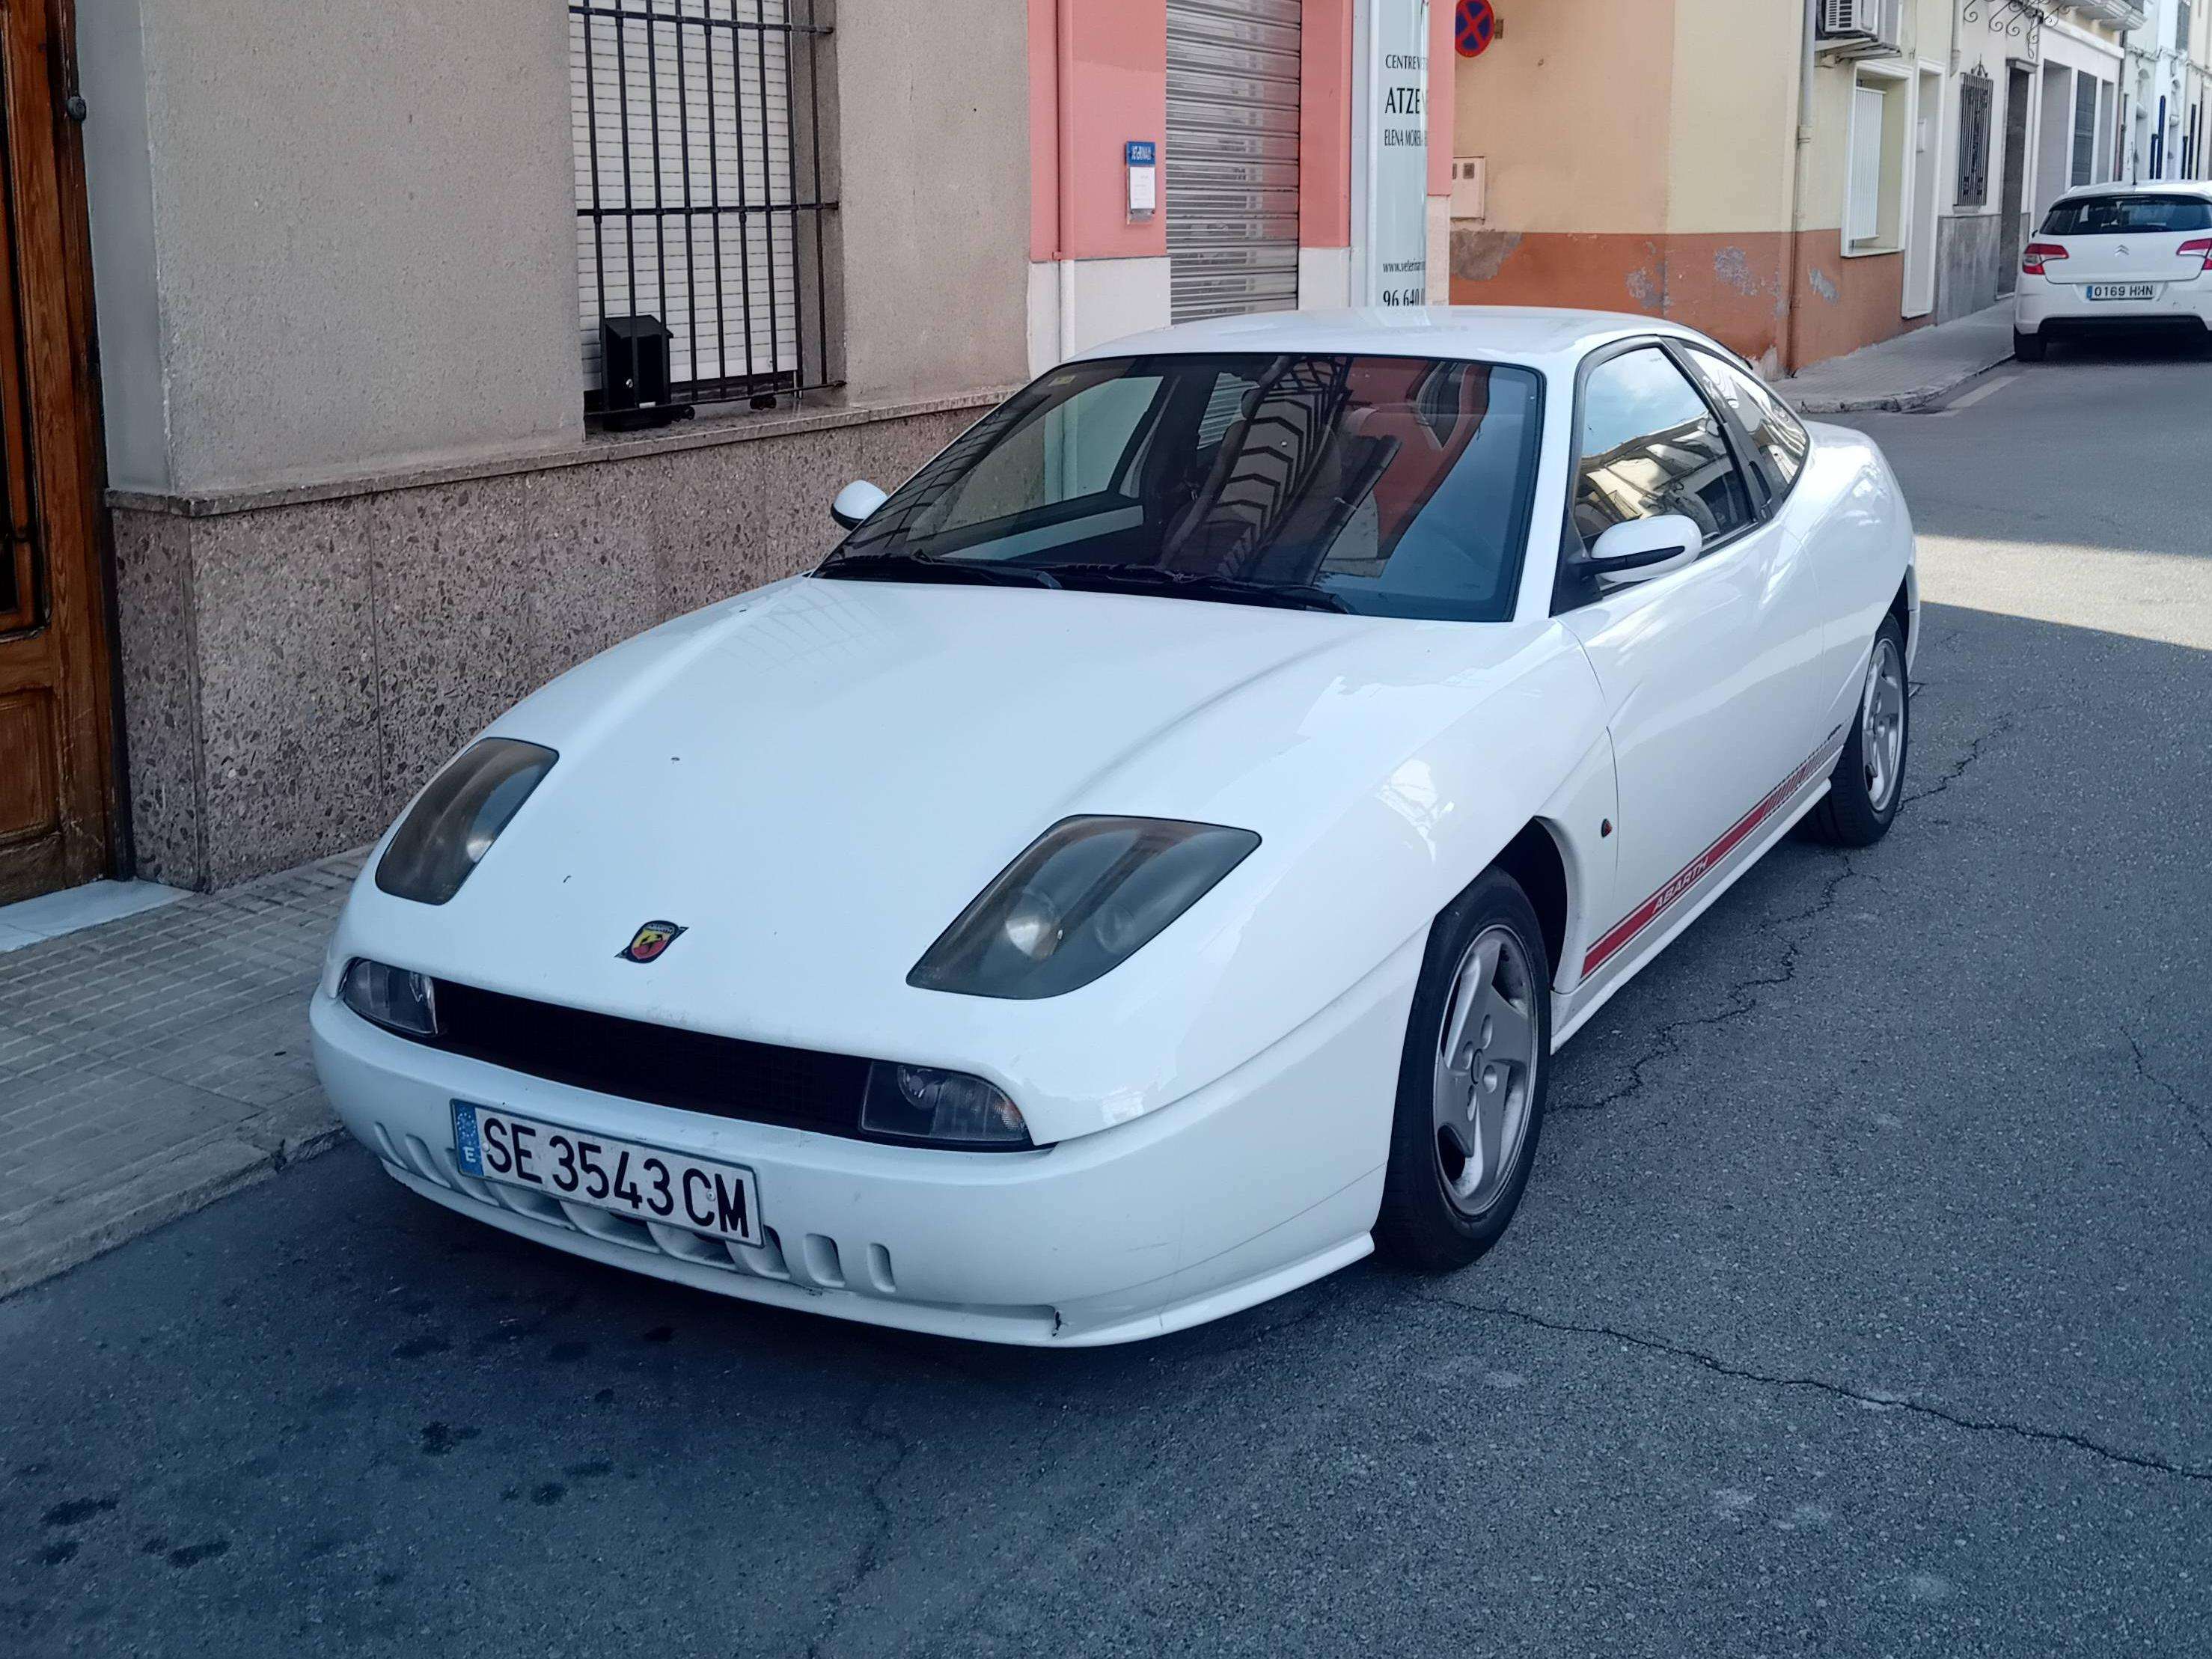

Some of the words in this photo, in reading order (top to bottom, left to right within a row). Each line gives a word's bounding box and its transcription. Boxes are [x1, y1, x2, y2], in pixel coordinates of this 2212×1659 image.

[1385, 55, 1416, 70] CENTRE
[1384, 129, 1404, 147] ELENA
[1383, 290, 1399, 307] 96
[2095, 286, 2125, 296] 0169
[2130, 285, 2154, 296] HHN
[1652, 855, 1709, 914] ABARTH
[462, 1146, 476, 1163] E
[483, 1117, 543, 1184] SE
[549, 1135, 674, 1216] 3543
[682, 1167, 749, 1238] CM
